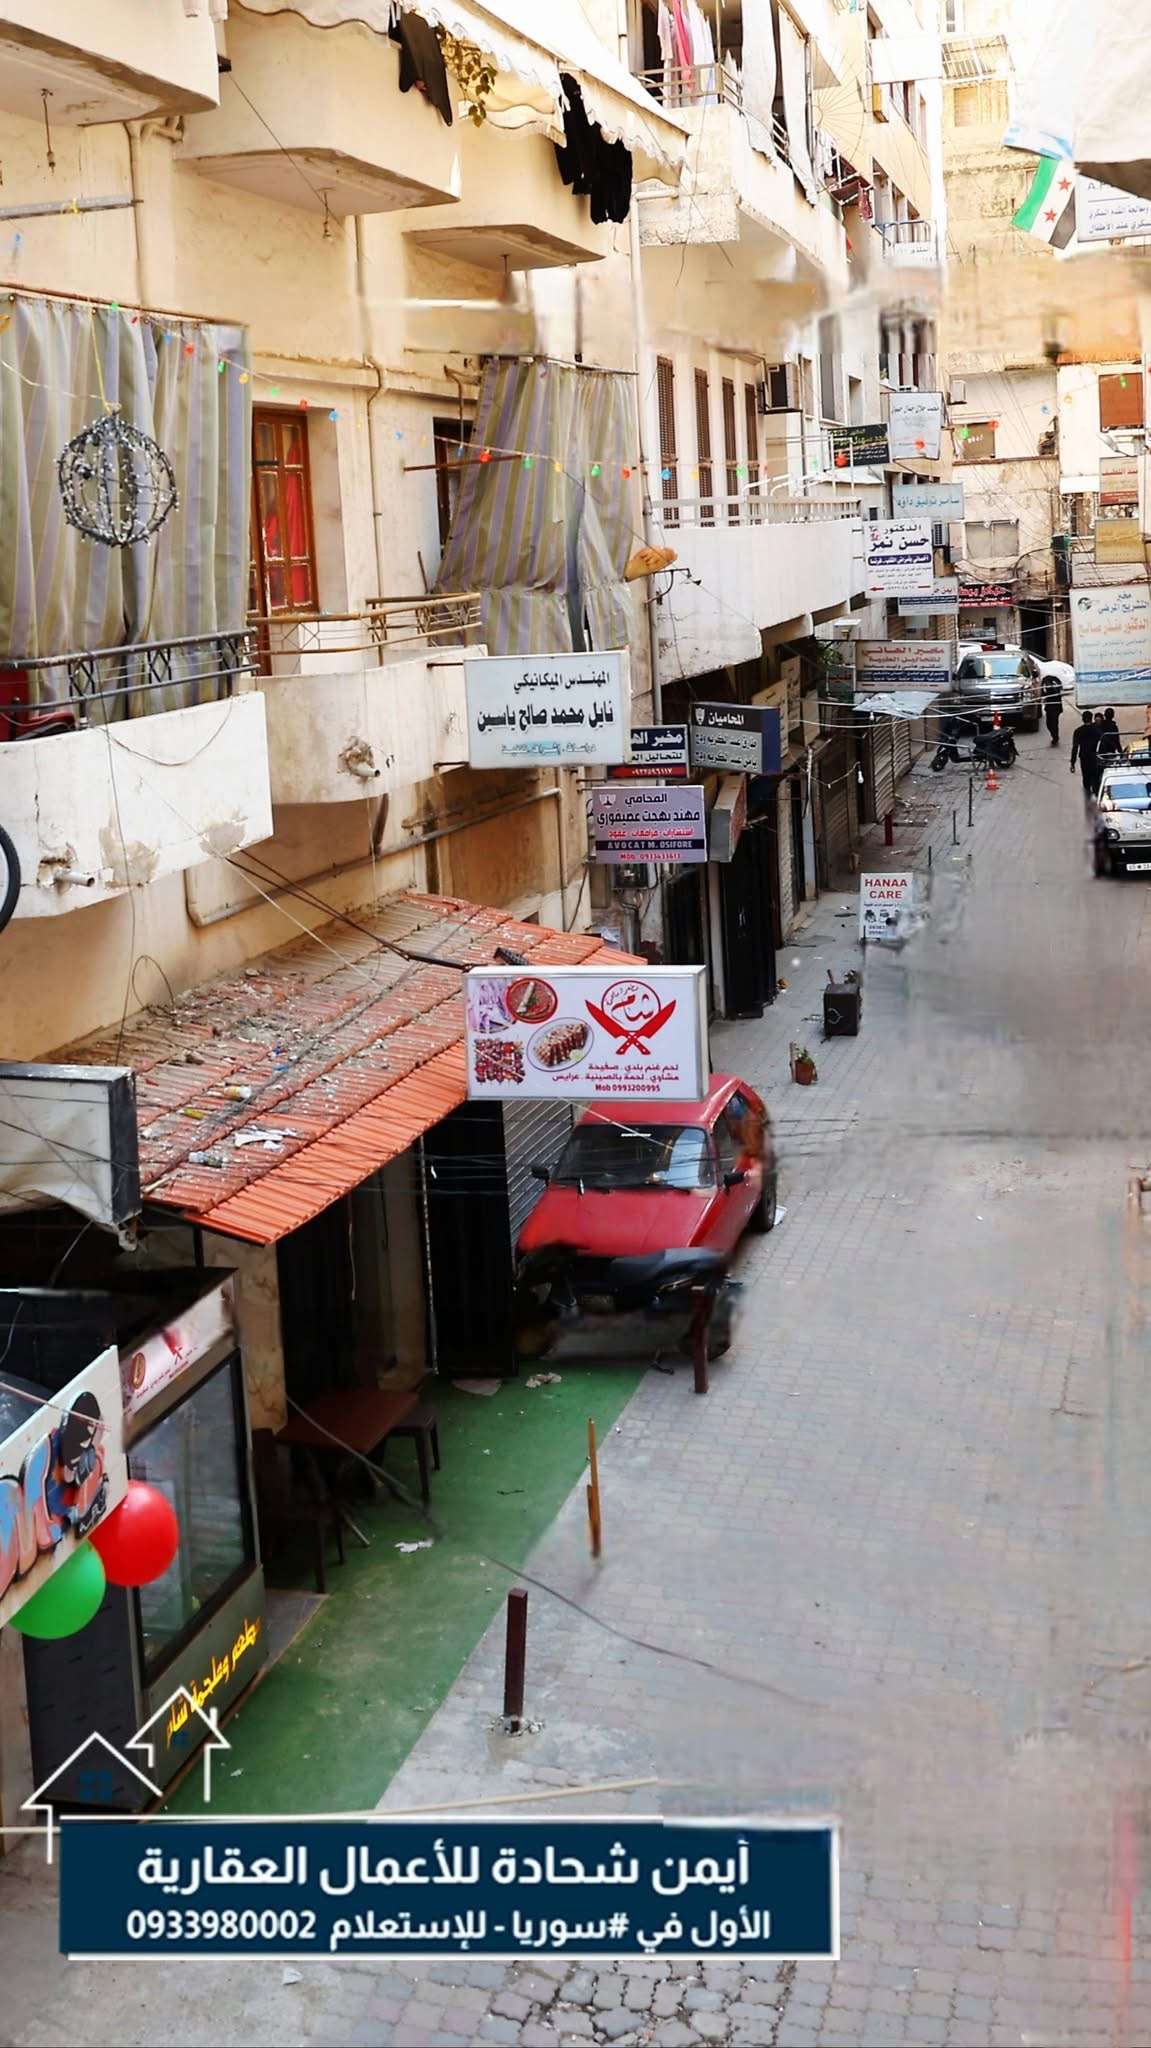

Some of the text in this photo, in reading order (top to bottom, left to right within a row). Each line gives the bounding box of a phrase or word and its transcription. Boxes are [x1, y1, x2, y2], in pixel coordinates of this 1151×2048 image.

[883, 523, 922, 535] الدكتور
[869, 535, 930, 552] حسن نمر
[513, 670, 610, 695] المهندس الميكانيكي
[477, 704, 516, 732] ياسين
[518, 703, 548, 732] صالح
[550, 706, 585, 725] محمد
[708, 711, 745, 727] المحاميان
[631, 731, 648, 745] اله
[651, 730, 684, 747] مخبر
[645, 751, 683, 763] للتحاليل
[624, 793, 668, 808] المحامي
[596, 808, 701, 829] مهند بهجت عصيفوري
[607, 840, 645, 850] AVOCAT
[647, 841, 659, 849] M.
[864, 878, 908, 888] HANAA
[869, 890, 903, 899] CARE
[588, 1061, 679, 1073] لحم غنم بلدي صفيحة
[551, 1072, 680, 1083] مشاوي لحمة بالصينية عرايس
[595, 1084, 611, 1092] Mob
